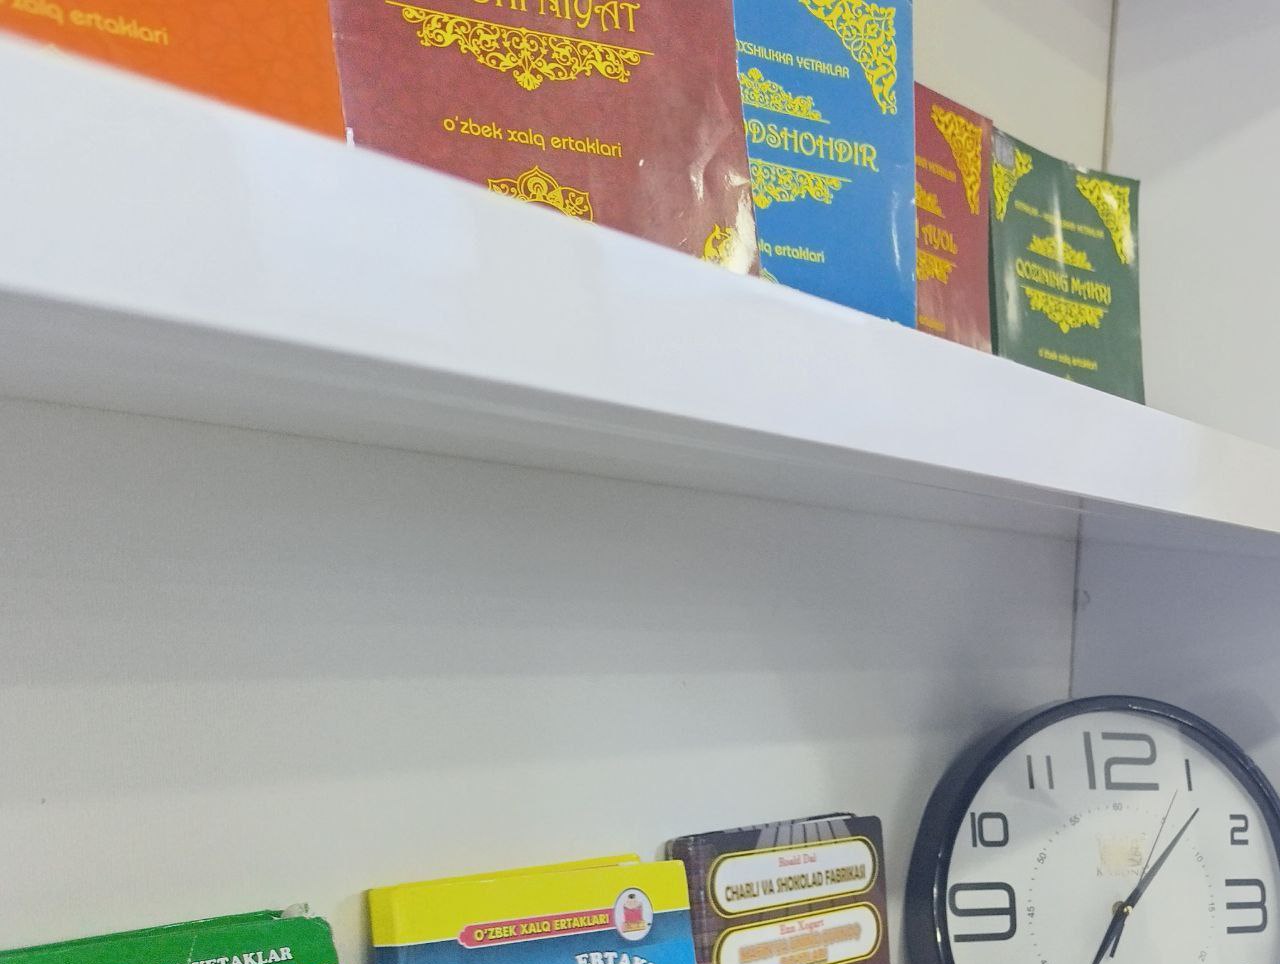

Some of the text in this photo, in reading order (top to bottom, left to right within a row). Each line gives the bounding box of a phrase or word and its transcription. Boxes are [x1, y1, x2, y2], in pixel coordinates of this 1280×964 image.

[69, 9, 170, 46] ertaklari
[796, 55, 850, 79] YETAKLAR
[443, 115, 623, 159] o'zbek xalq ertaklari
[744, 118, 879, 173] DSHOHDIR
[774, 244, 825, 264] ertaklari
[1026, 754, 1055, 790] 11
[1083, 731, 1160, 792] 12
[1184, 758, 1193, 791] 1
[970, 811, 1010, 848] 10
[1229, 813, 1250, 846] 2
[725, 863, 867, 902] CHARLI VA SHOKOLAD FABRIKASI
[948, 881, 1017, 943] 9
[1224, 878, 1268, 934] 3
[473, 913, 610, 942] O'ZBEK XALQ ERTAKLARI
